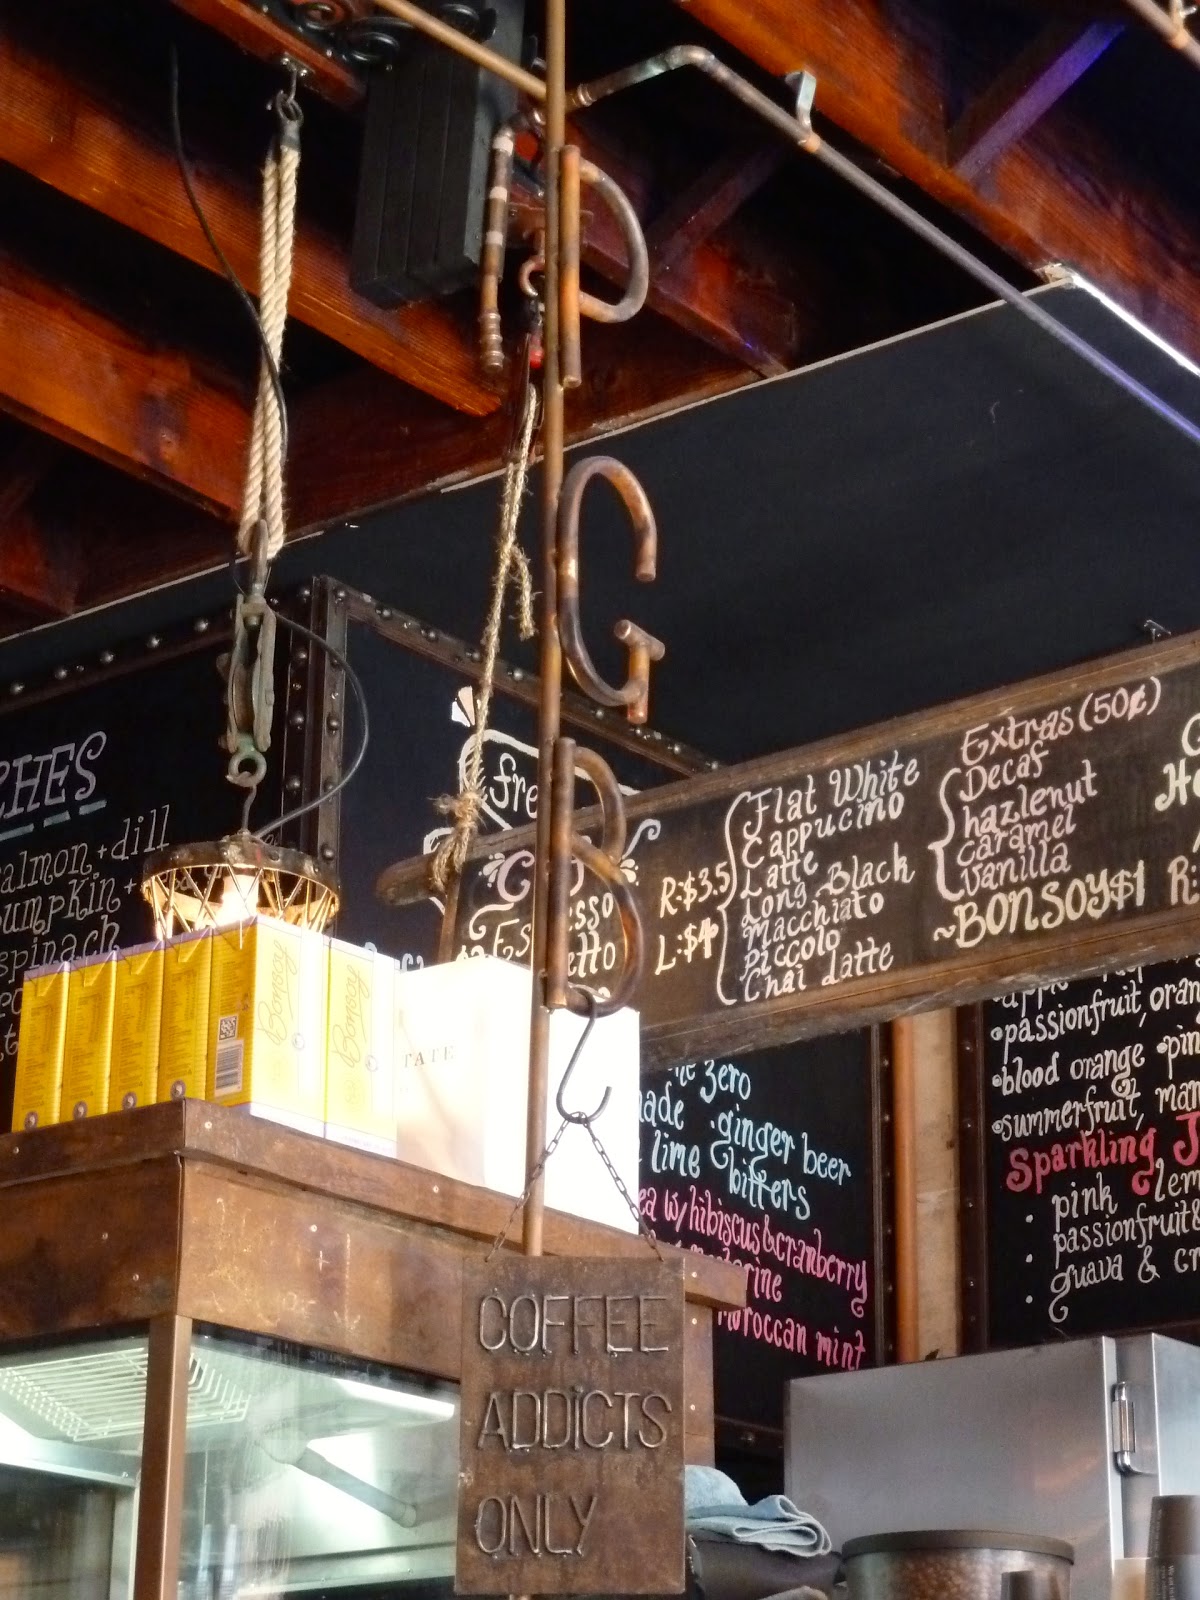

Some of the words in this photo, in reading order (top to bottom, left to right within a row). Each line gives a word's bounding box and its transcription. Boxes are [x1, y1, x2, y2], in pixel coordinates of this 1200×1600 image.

[961, 706, 1074, 766] Extras
[743, 775, 817, 840] Flat
[829, 750, 920, 807] White
[960, 740, 1049, 802] Decaf
[963, 759, 1098, 839] hazlenut
[742, 792, 905, 868] Cappucino
[0, 843, 92, 894] almon
[741, 881, 807, 927] Long
[816, 842, 916, 896] Black
[1002, 1051, 1060, 1097] blood
[1070, 1043, 1145, 1098] orange
[651, 1130, 700, 1179] lime
[729, 1147, 811, 1220] bitters
[802, 1132, 852, 1185] beer
[1006, 1127, 1157, 1196] Sparkling
[1052, 1172, 1118, 1233] pink
[1048, 1254, 1124, 1323] guava
[1138, 1245, 1160, 1283] &
[479, 1295, 669, 1354] COFFEE
[816, 1326, 866, 1371] mint
[477, 1389, 672, 1450] ADDICTS
[475, 1495, 597, 1555] ONLY
